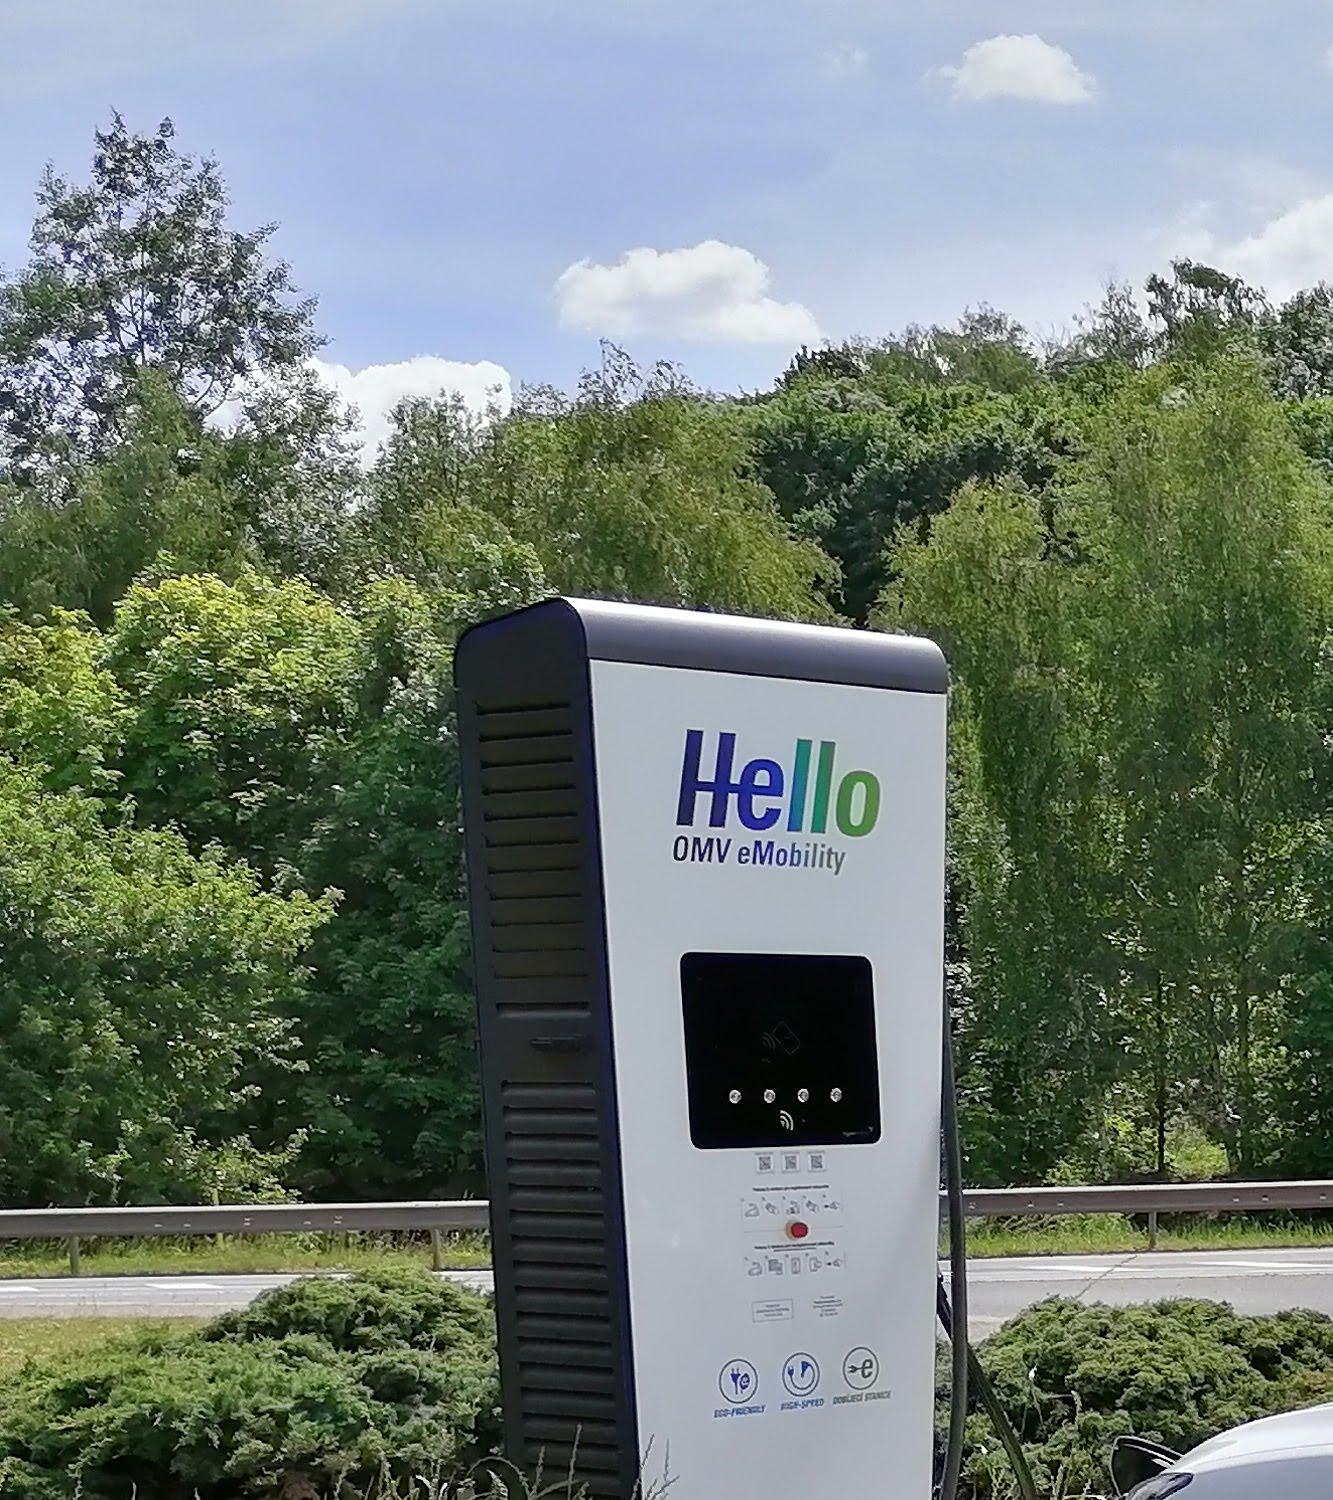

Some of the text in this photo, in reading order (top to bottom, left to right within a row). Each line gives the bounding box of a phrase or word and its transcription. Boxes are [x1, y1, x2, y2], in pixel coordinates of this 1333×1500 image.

[676, 729, 881, 838] Hello
[673, 835, 847, 876] OMV eMobility
